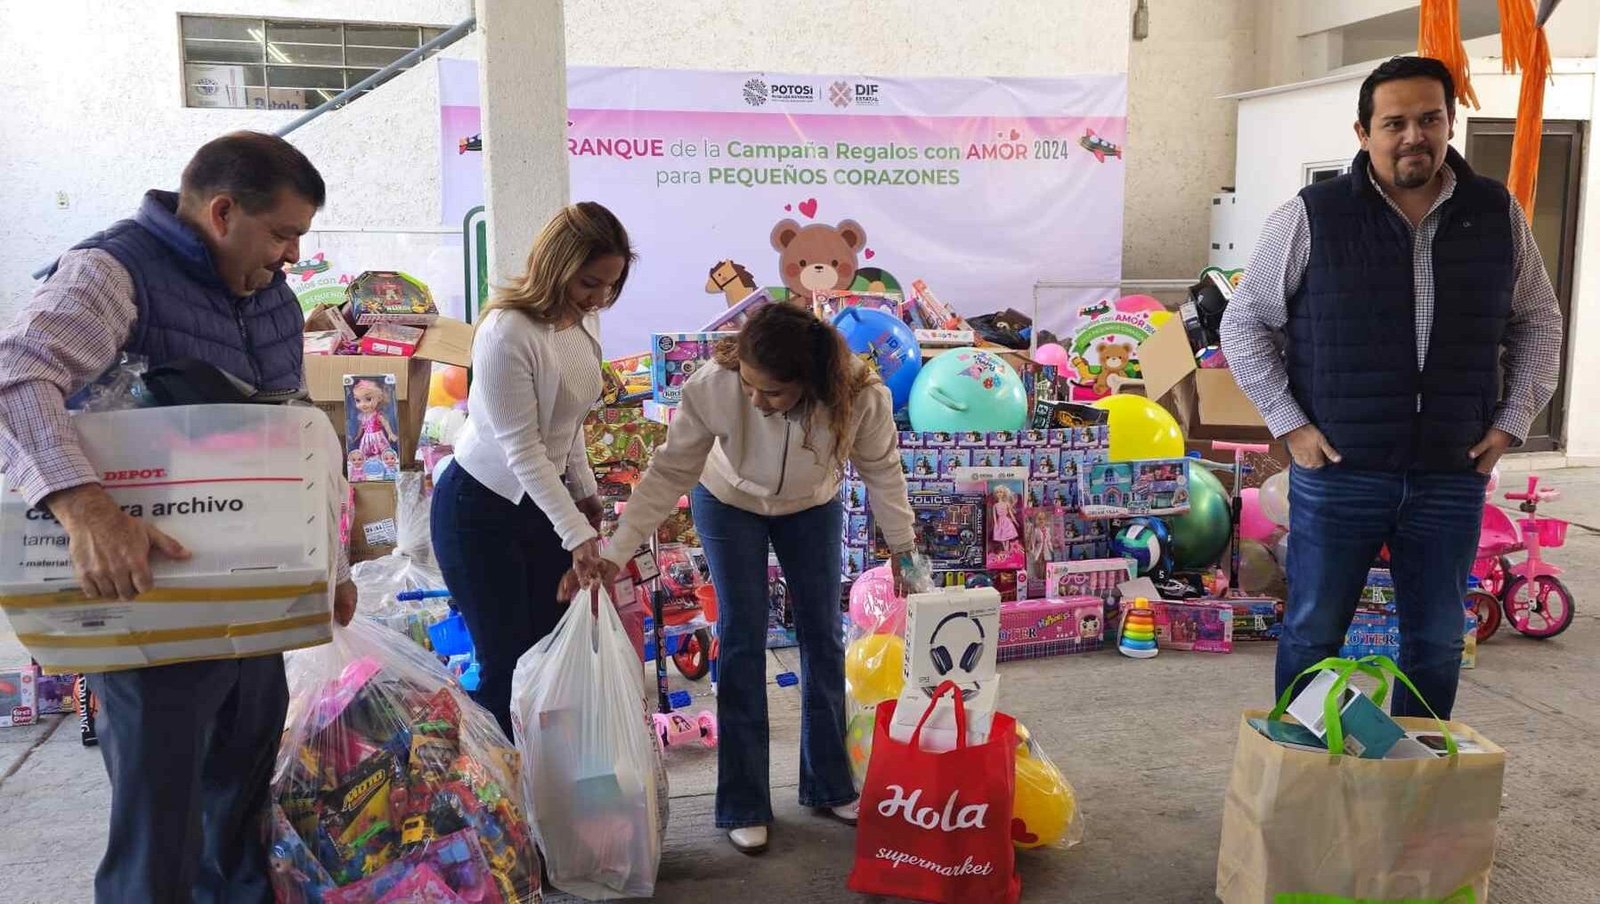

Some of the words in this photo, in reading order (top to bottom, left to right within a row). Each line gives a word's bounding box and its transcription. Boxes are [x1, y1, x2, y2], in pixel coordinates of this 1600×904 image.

[855, 84, 879, 95] DIF
[568, 138, 664, 159] RANQUE
[670, 139, 697, 157] de
[703, 140, 721, 158] la
[727, 141, 829, 163] Campaña
[836, 142, 918, 164] Regalos
[924, 147, 960, 161] con
[966, 143, 1027, 161] AMOR
[1034, 140, 1068, 160] 2024
[656, 171, 701, 188] para
[708, 164, 828, 187] PEQUEÑOS
[833, 168, 960, 185] CORAZONES
[1115, 314, 1145, 327] AMOR
[152, 496, 244, 517] archivo
[907, 496, 951, 504] POLICE
[878, 785, 989, 832] Hola
[876, 847, 993, 877] supermarket
